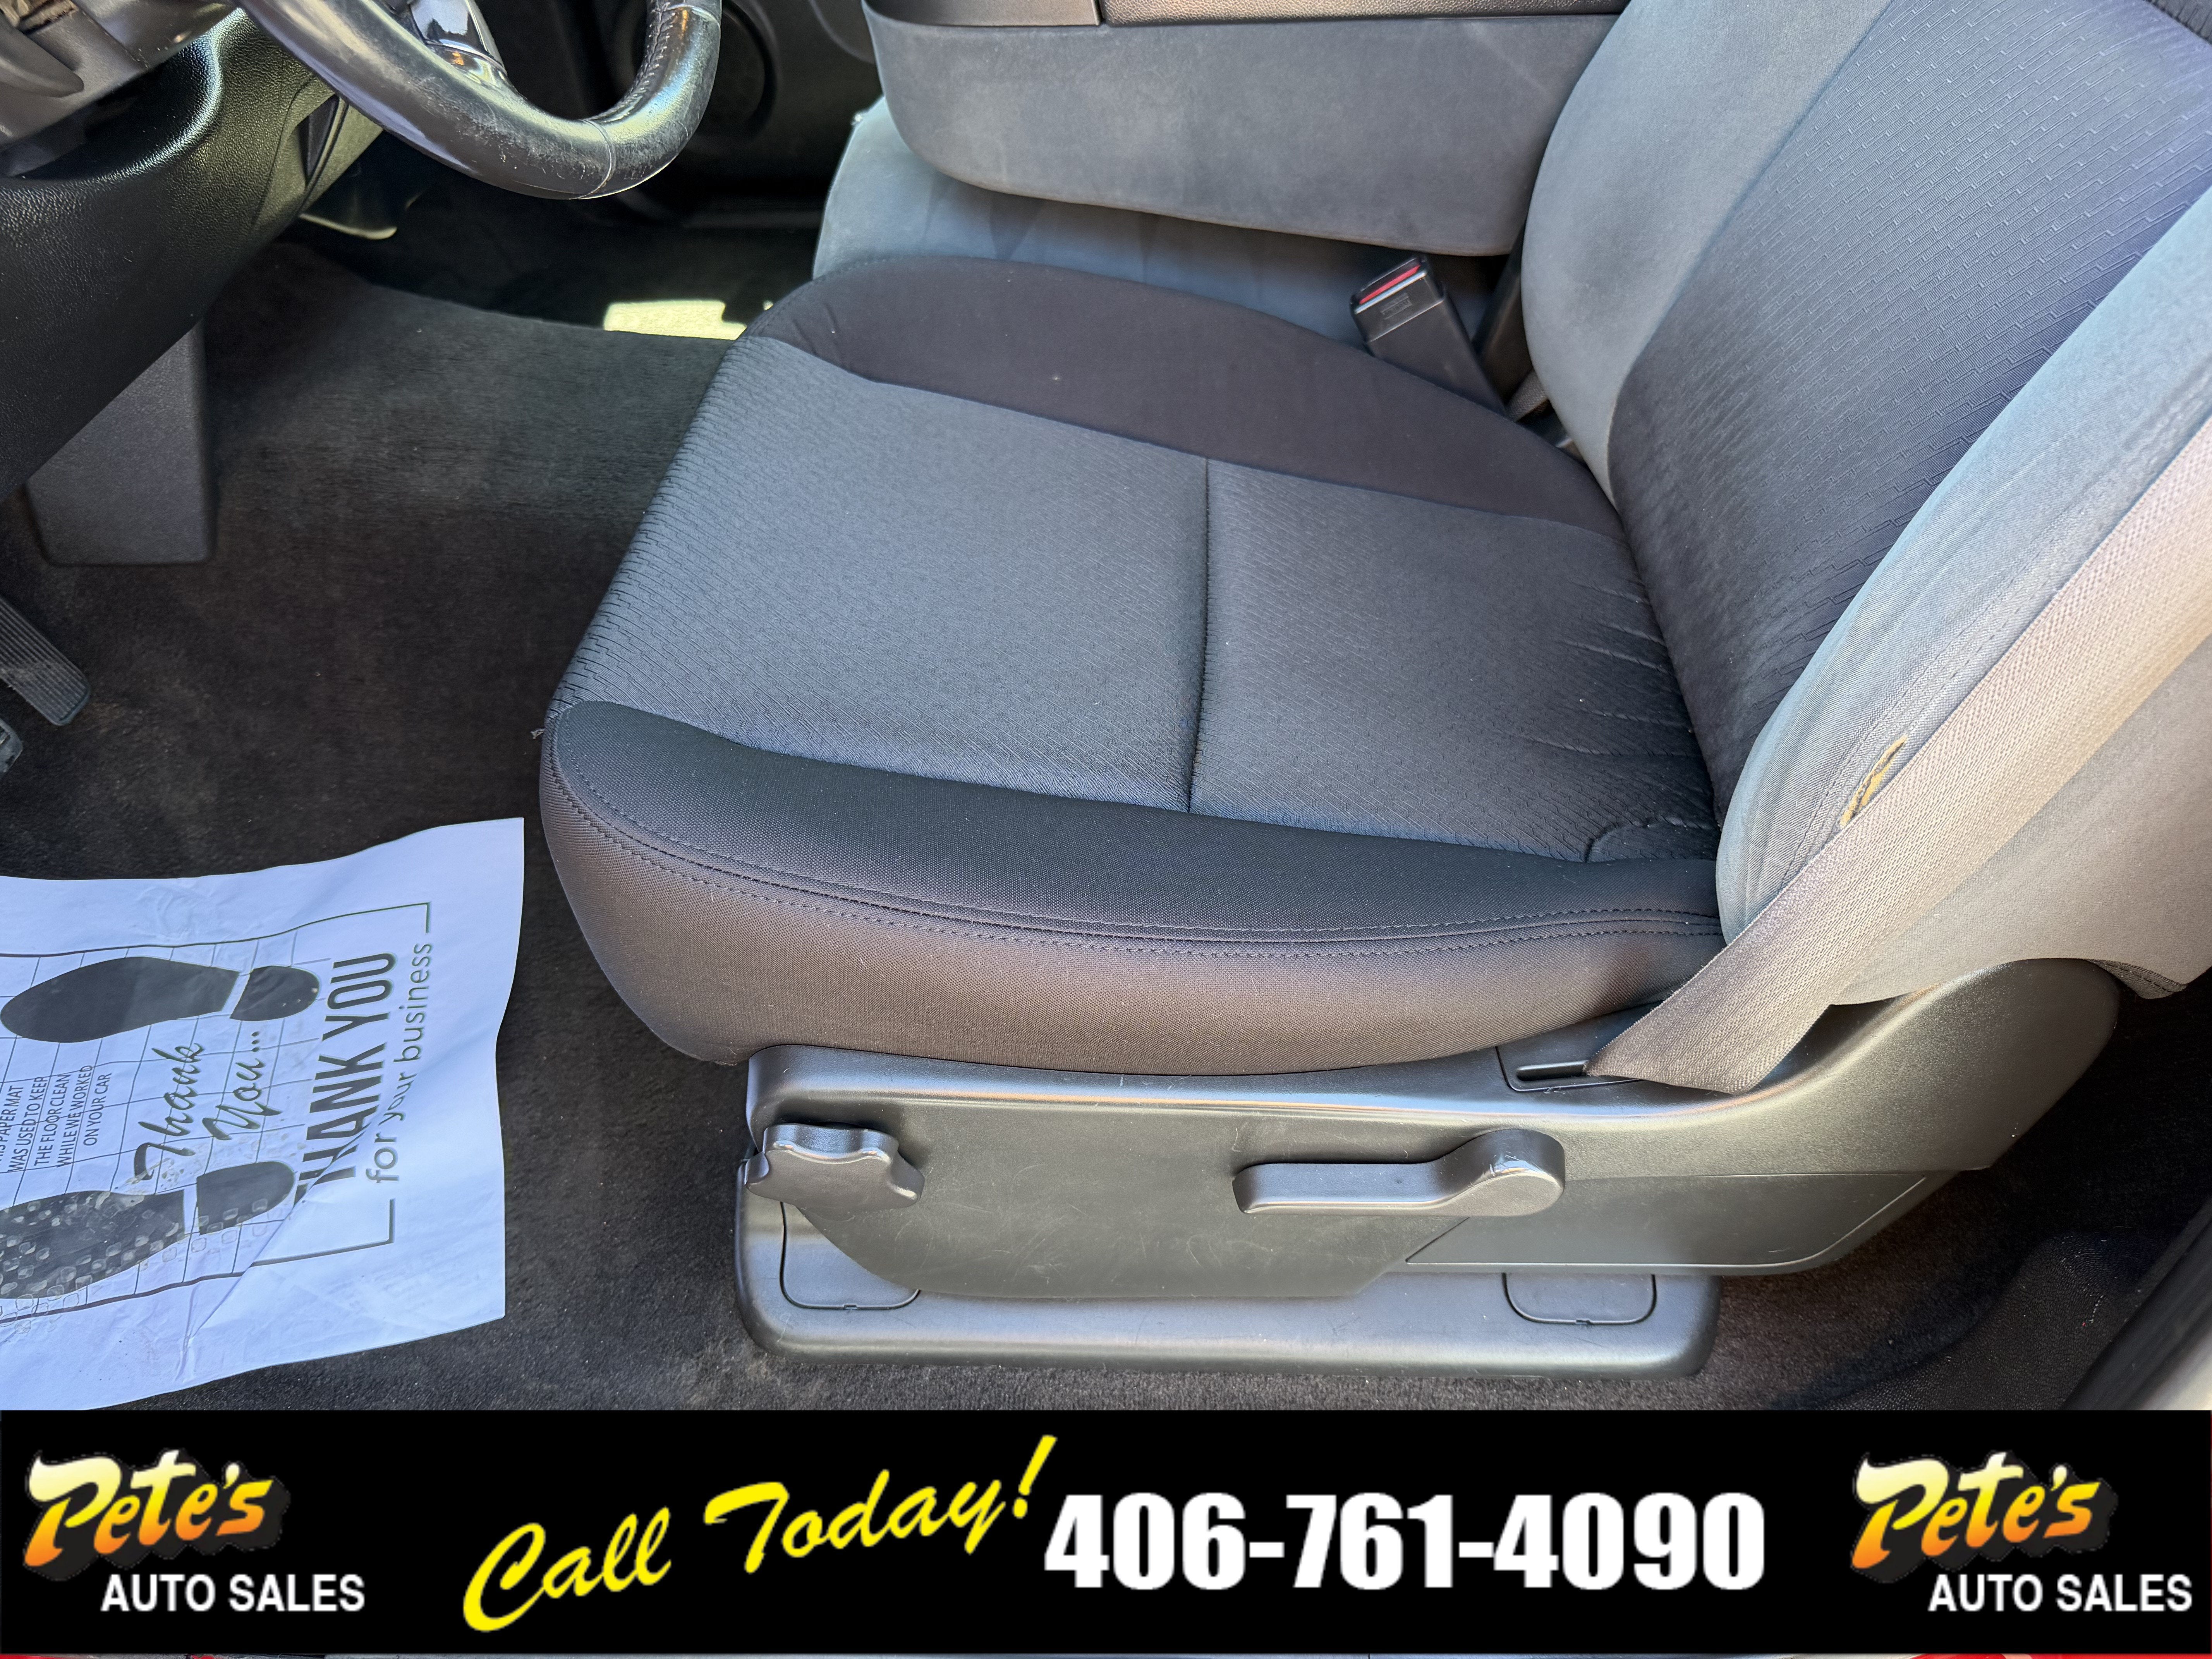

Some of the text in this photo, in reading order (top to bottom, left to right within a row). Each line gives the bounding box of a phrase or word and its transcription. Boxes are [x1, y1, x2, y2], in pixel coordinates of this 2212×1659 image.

[322, 953, 397, 1041] YOU
[3, 1085, 24, 1106] MAT
[83, 1073, 112, 1146] ON YOUR CAR
[366, 943, 432, 1183] for your business
[7, 1077, 48, 1172] WAS USED TO KEEP
[34, 1074, 71, 1166] THE FLOOR CLEAN
[57, 1065, 93, 1168] WHILE WE WORKED
[134, 1043, 204, 1180] Thank
